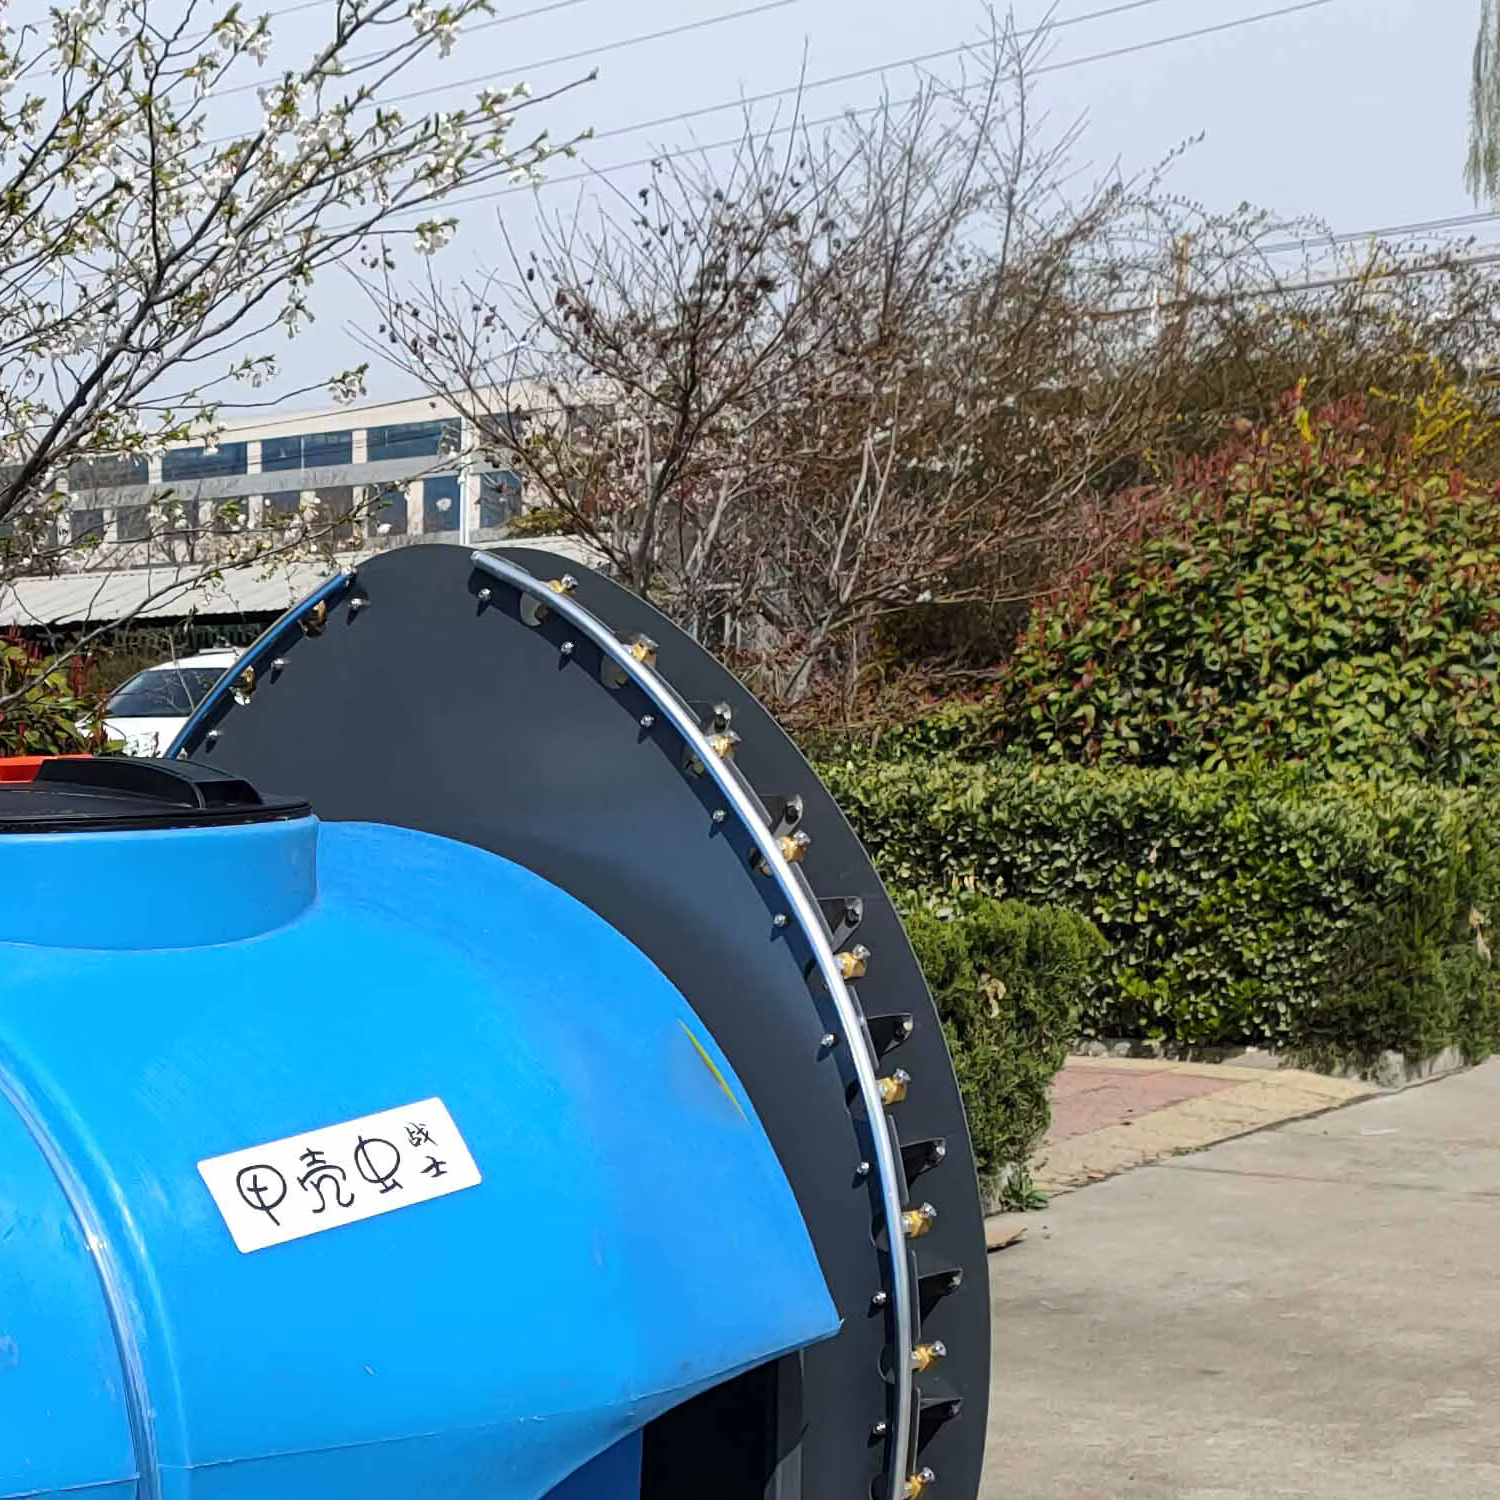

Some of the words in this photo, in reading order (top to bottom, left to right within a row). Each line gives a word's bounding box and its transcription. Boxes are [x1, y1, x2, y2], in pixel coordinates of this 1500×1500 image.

[236, 1136, 403, 1226] 甲壳虫
[404, 1122, 447, 1178] 战士
